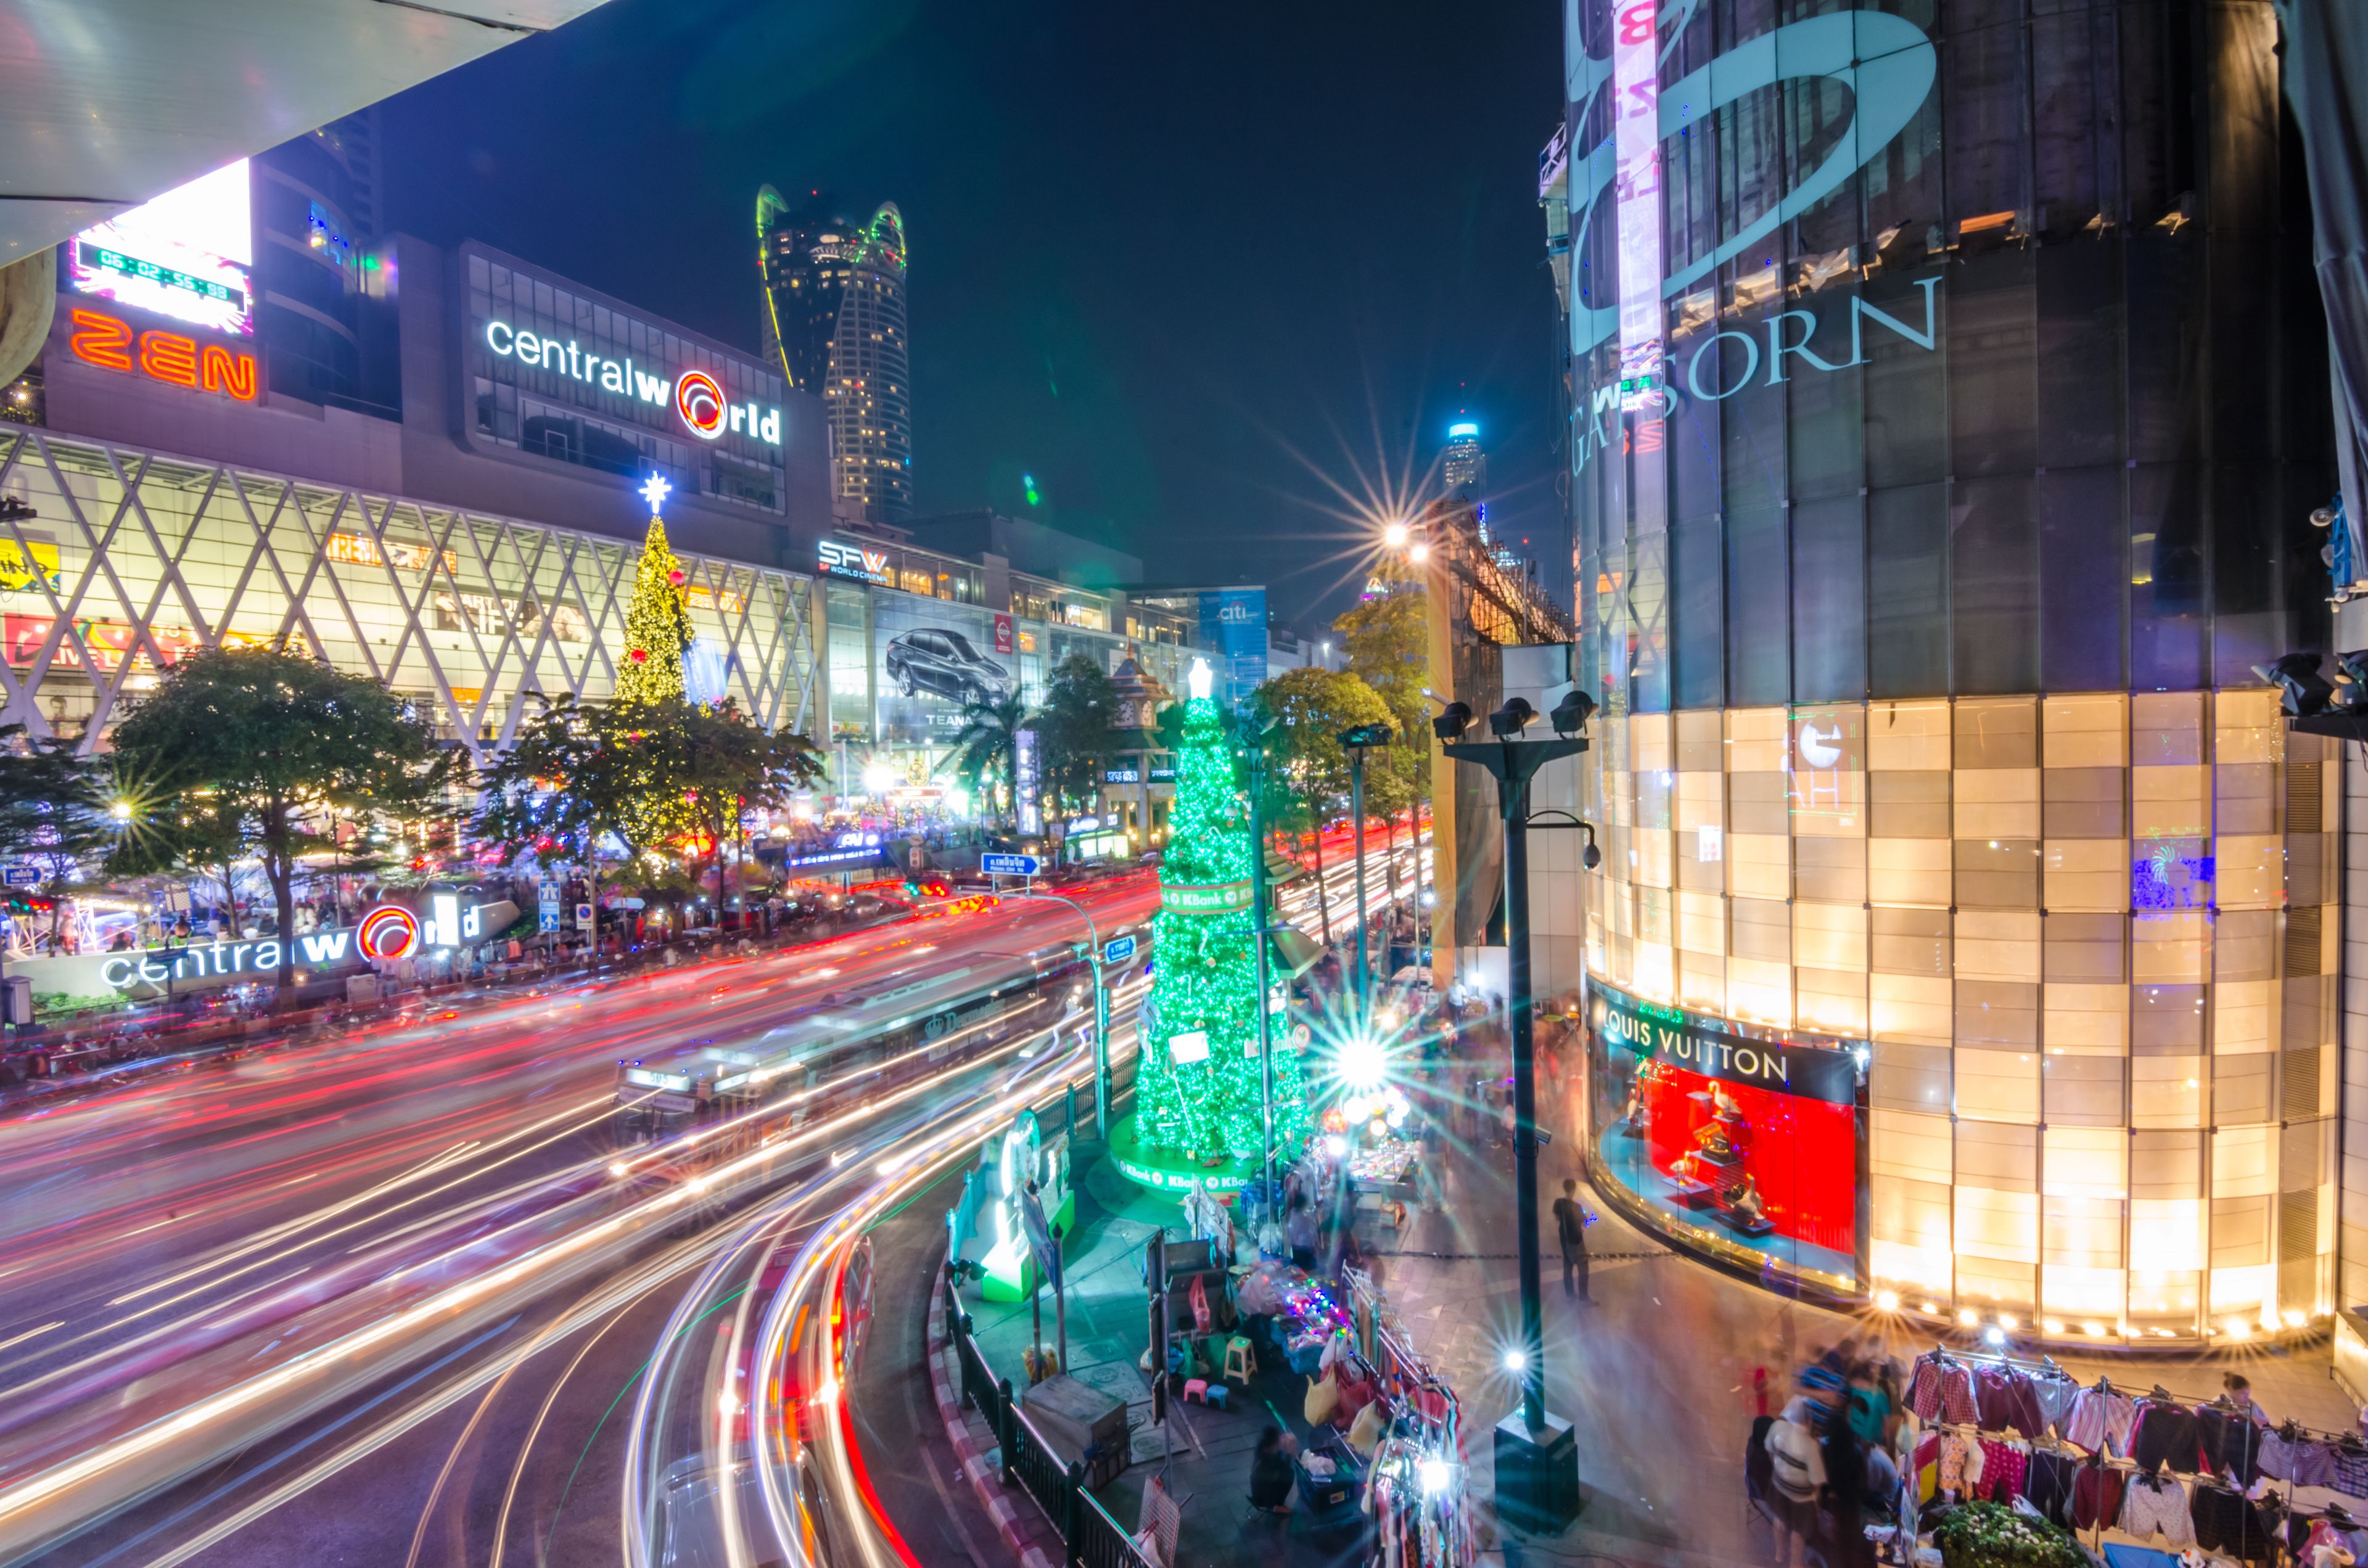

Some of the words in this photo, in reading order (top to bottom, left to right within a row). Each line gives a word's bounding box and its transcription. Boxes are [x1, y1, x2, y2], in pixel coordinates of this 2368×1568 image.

[70, 308, 256, 401] ZEN
[487, 321, 781, 445] centralworld
[818, 541, 888, 573] SFW
[818, 562, 830, 571] SF
[831, 566, 858, 577] WORLD
[859, 572, 888, 583] CINEMA
[1219, 604, 1246, 620] citi
[926, 715, 974, 726] TEANA
[1182, 892, 1222, 906] KBank
[1604, 1006, 1651, 1046] LOUIS
[1659, 1028, 1788, 1082] VUITTON
[649, 1071, 668, 1084] 505
[1126, 1164, 1151, 1182] KBank
